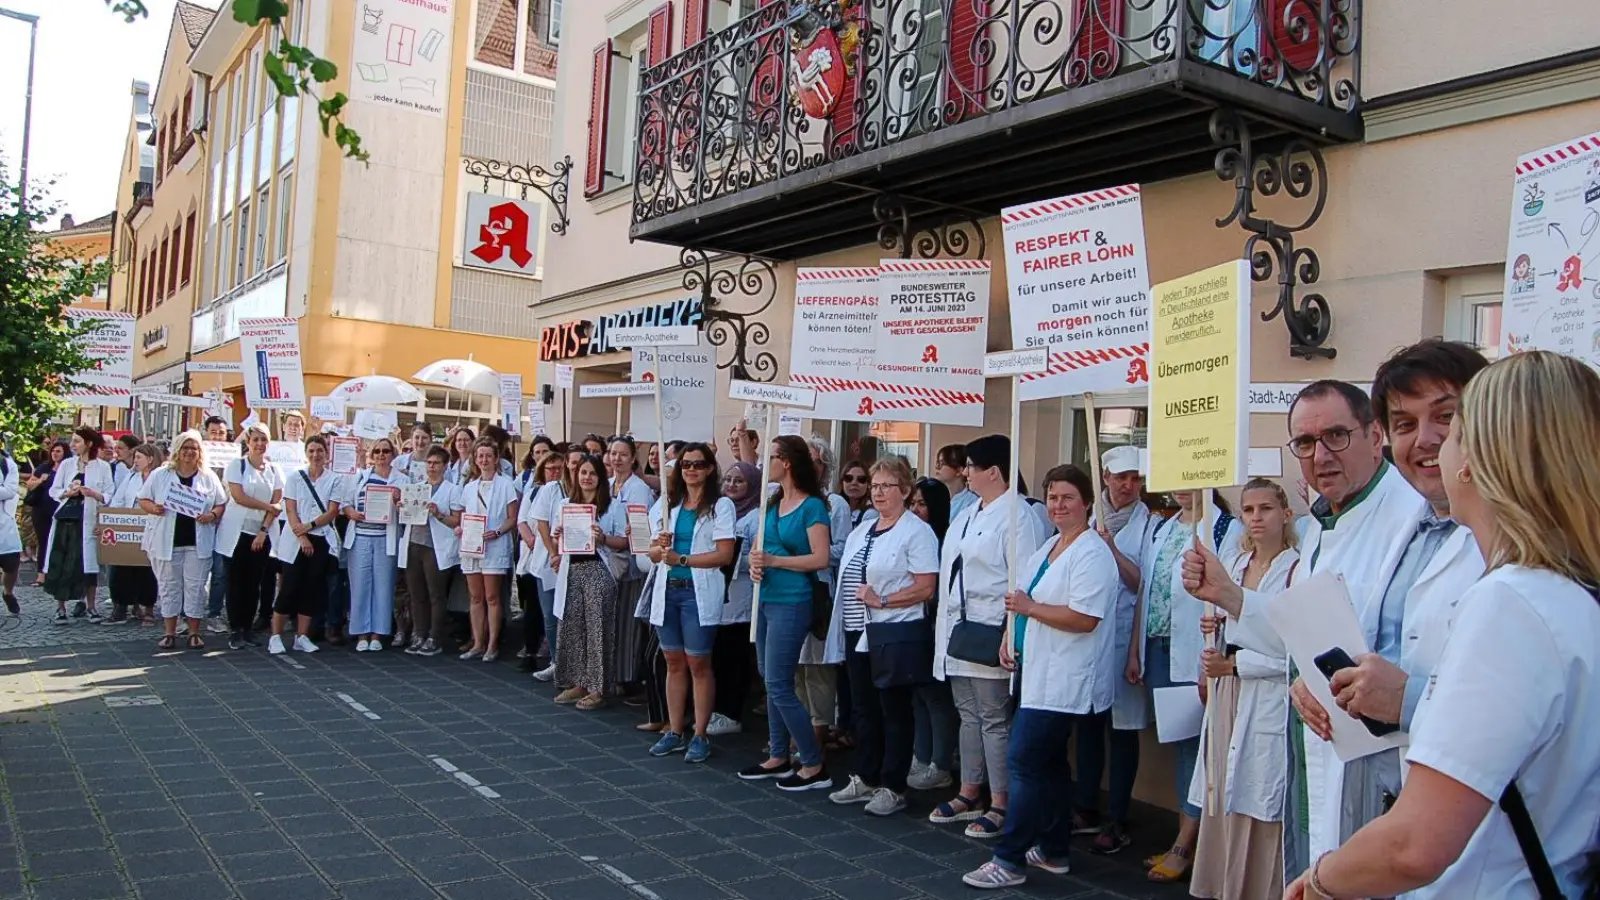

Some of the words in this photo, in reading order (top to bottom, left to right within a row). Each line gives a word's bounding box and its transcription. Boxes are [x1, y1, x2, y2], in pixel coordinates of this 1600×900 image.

[373, 93, 393, 103] jeder
[395, 98, 413, 107] kann
[415, 102, 442, 113] kaufen!
[1015, 229, 1090, 254] RESPEKT
[1094, 231, 1107, 246] &
[1023, 252, 1082, 274] FAIRER
[1087, 243, 1135, 263] LOHN
[901, 283, 966, 292] BUNDESWEITER
[1017, 285, 1036, 296] für
[1041, 277, 1086, 292] unsere
[1090, 267, 1137, 284] Arbeit!
[1161, 290, 1182, 304] Jeden
[1184, 286, 1197, 297] Tag
[1199, 276, 1228, 292] schließt
[891, 291, 976, 305] PROTESTTAG
[1052, 300, 1088, 314] Damit
[1092, 296, 1111, 307] wir
[1115, 291, 1146, 304] auch
[1158, 305, 1165, 316] in
[1167, 293, 1211, 313] Deutschland
[1212, 290, 1229, 302] eine
[803, 311, 816, 319] bei
[947, 304, 966, 312] 2023
[883, 320, 912, 328] UNSERE
[914, 318, 955, 326] APOTHEKE
[956, 317, 984, 325] BLEIBT
[1037, 315, 1092, 332] morgen
[1094, 309, 1125, 322] noch
[1130, 307, 1148, 318] für
[1172, 309, 1214, 330] Apotheke
[241, 329, 285, 337] ARZNEIMITTEL
[808, 324, 841, 333] können
[844, 325, 872, 334] töten!
[917, 326, 976, 334] GESCHLOSSEN!
[1026, 336, 1044, 347] Sie
[1048, 333, 1063, 344] da
[1067, 330, 1093, 341] sein
[1097, 321, 1149, 337] können!
[615, 333, 679, 342] Einhorn-Apotheke
[877, 364, 924, 372] GESUNDHEIT
[1157, 354, 1229, 378] Übermorgen
[742, 386, 792, 400] Kur-Apotheke
[1165, 395, 1219, 417] UNSERE!
[1179, 436, 1209, 447] brunnen
[1192, 448, 1227, 460] apotheke
[1182, 468, 1226, 481] Marktbergel
